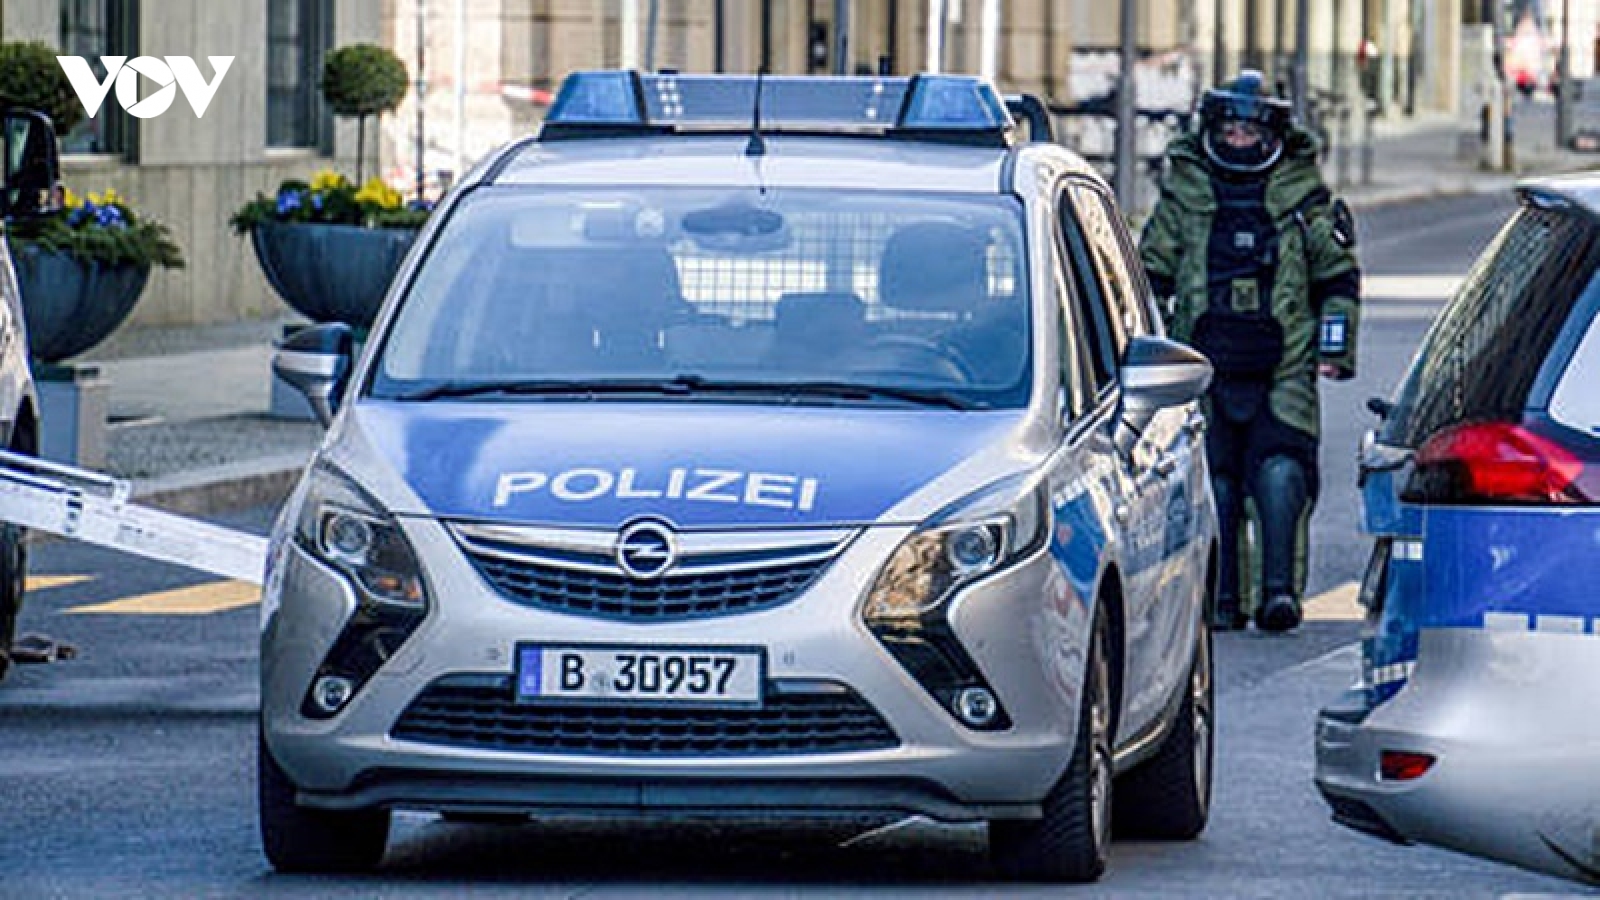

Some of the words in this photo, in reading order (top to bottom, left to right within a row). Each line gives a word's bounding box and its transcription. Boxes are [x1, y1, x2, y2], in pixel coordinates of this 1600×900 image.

[493, 467, 818, 511] POLIZEI
[560, 653, 585, 691] B
[613, 654, 736, 694] 30957
